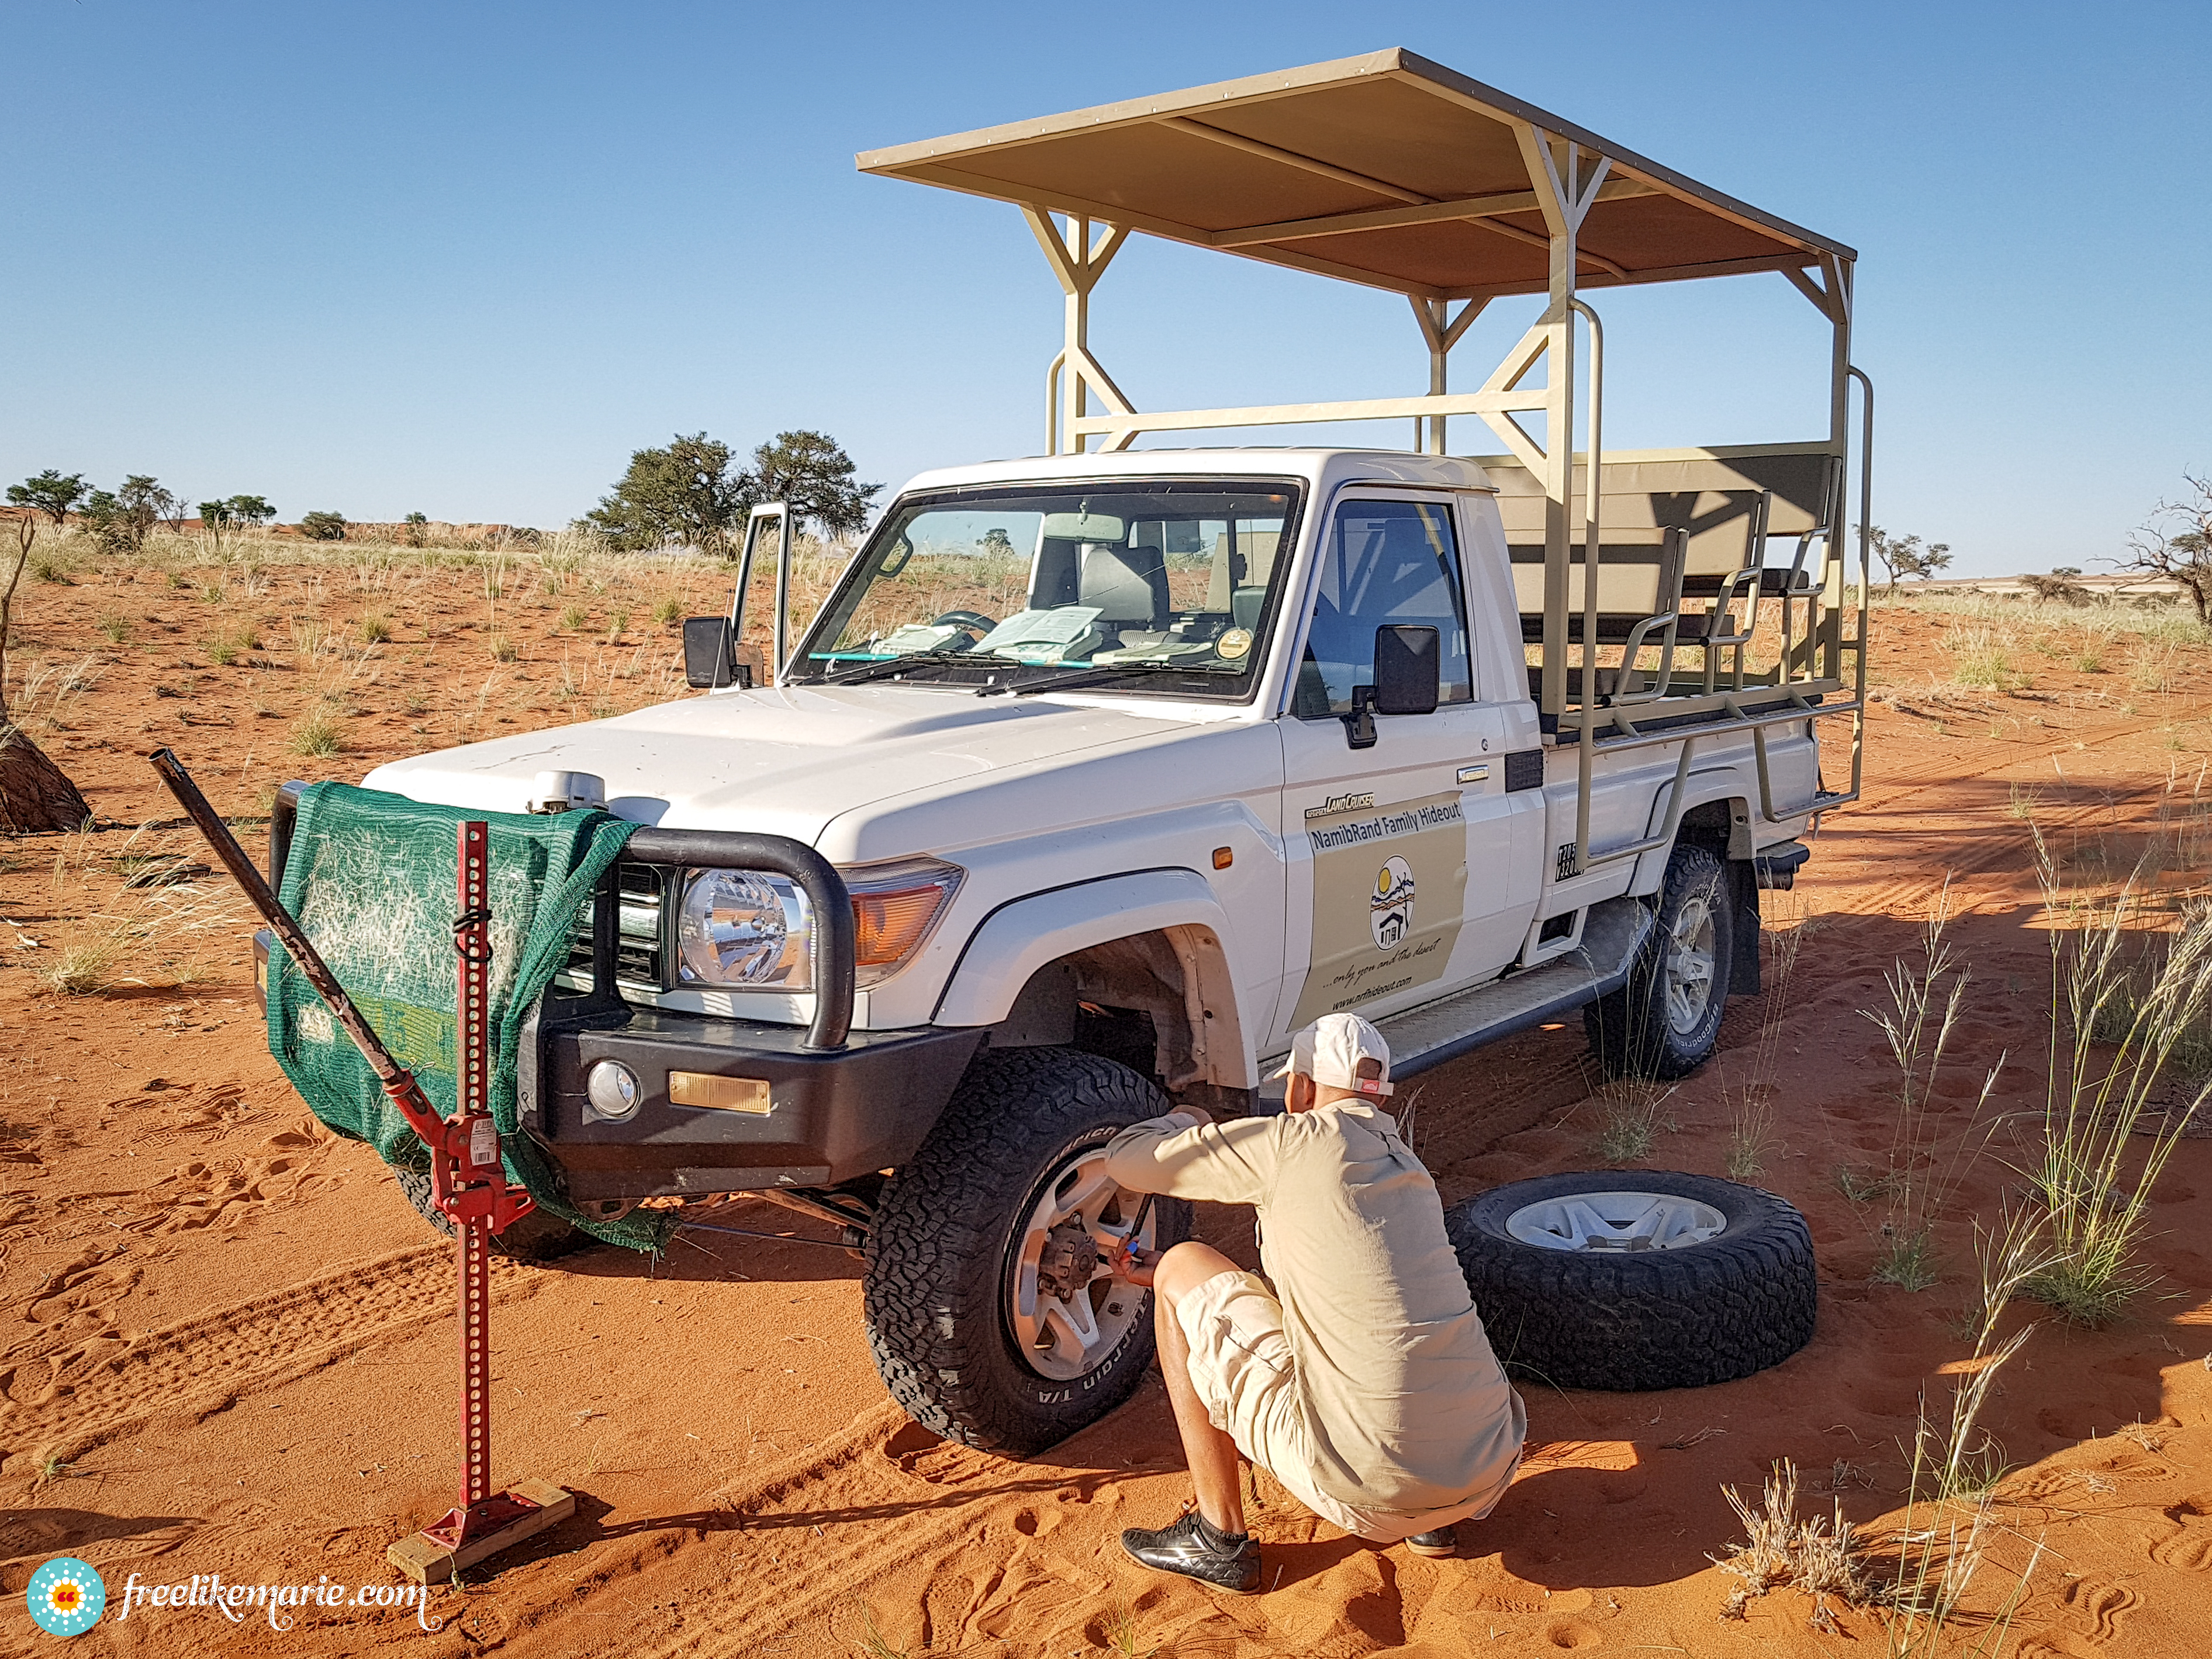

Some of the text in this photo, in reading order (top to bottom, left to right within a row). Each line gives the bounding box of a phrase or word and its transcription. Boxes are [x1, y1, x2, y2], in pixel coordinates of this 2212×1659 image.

[1311, 802, 1461, 849] NamibRand Family Hideout
[1353, 967, 1374, 986] you
[1377, 951, 1399, 969] and
[1412, 938, 1441, 958] desert
[1039, 1389, 1073, 1404] T/A
